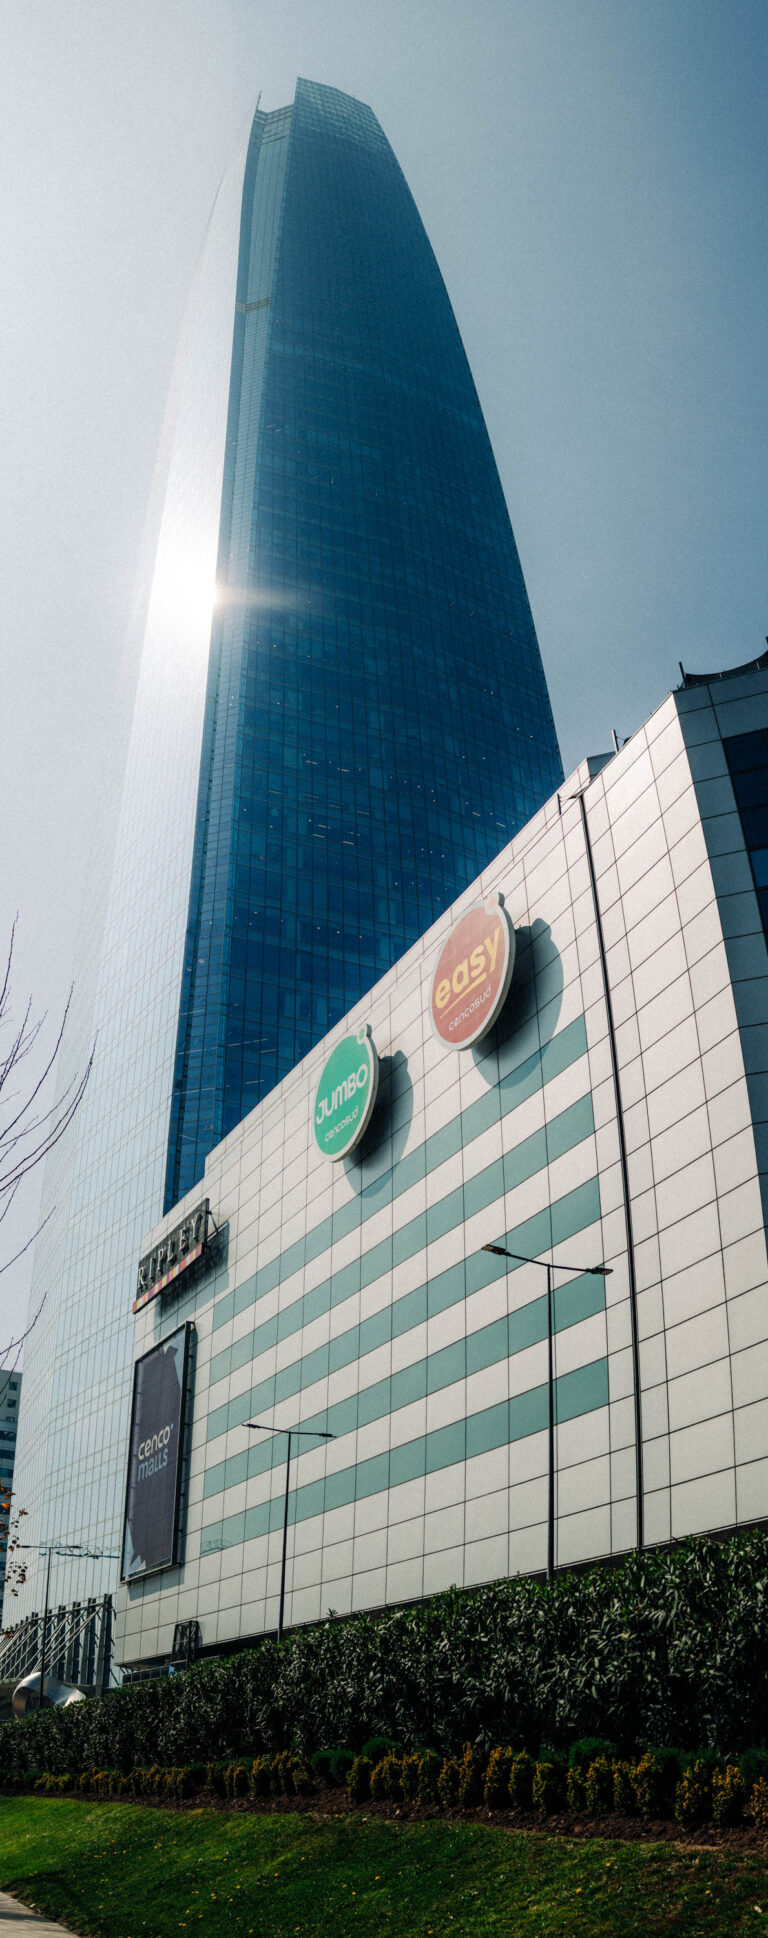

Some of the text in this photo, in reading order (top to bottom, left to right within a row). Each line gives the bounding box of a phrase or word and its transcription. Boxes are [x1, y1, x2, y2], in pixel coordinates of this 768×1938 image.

[434, 926, 501, 1009] easy
[448, 984, 492, 1031] cencosud
[316, 1063, 368, 1125] JUMBO
[324, 1104, 359, 1142] cencosud
[137, 1212, 203, 1289] RIPLEY
[137, 1448, 168, 1482] malls
[138, 1425, 171, 1460] cenco
